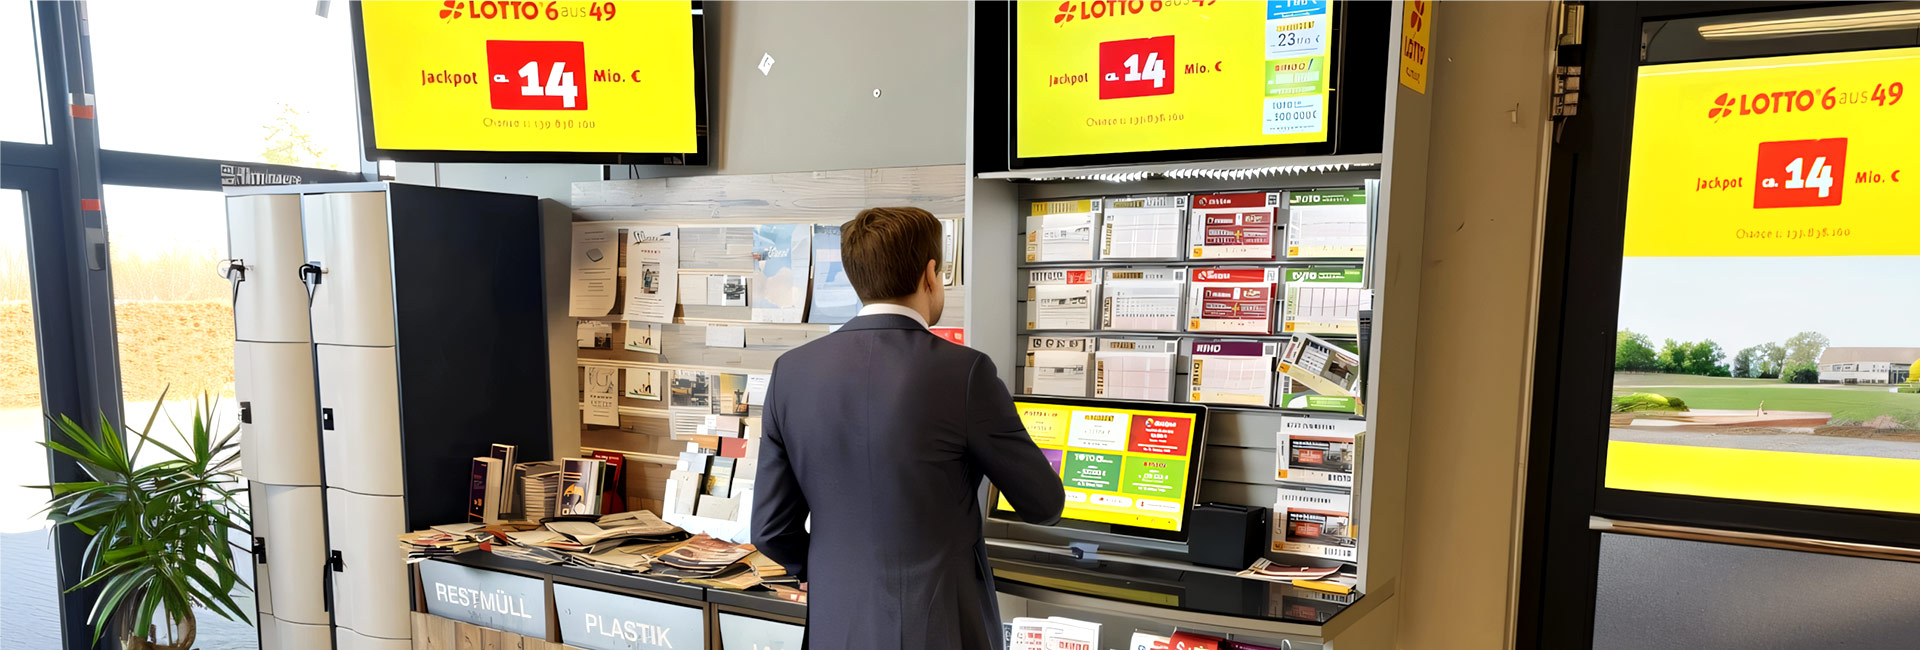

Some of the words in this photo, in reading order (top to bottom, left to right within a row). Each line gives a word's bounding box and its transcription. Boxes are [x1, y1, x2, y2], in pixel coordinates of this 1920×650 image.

[469, 1, 539, 20] LOTTO
[421, 70, 478, 86] Jackpot
[518, 61, 578, 108] 14
[593, 69, 626, 83] Mio.
[1049, 73, 1089, 88] Jackpot
[1123, 52, 1166, 88] 14
[1739, 89, 1815, 116] LOTTO
[1696, 176, 1743, 192] Jackpot
[1785, 156, 1833, 198] 14
[1855, 171, 1885, 184] Mio.
[435, 582, 531, 619] RESTMÜLL
[585, 613, 673, 649] PLASTIK
